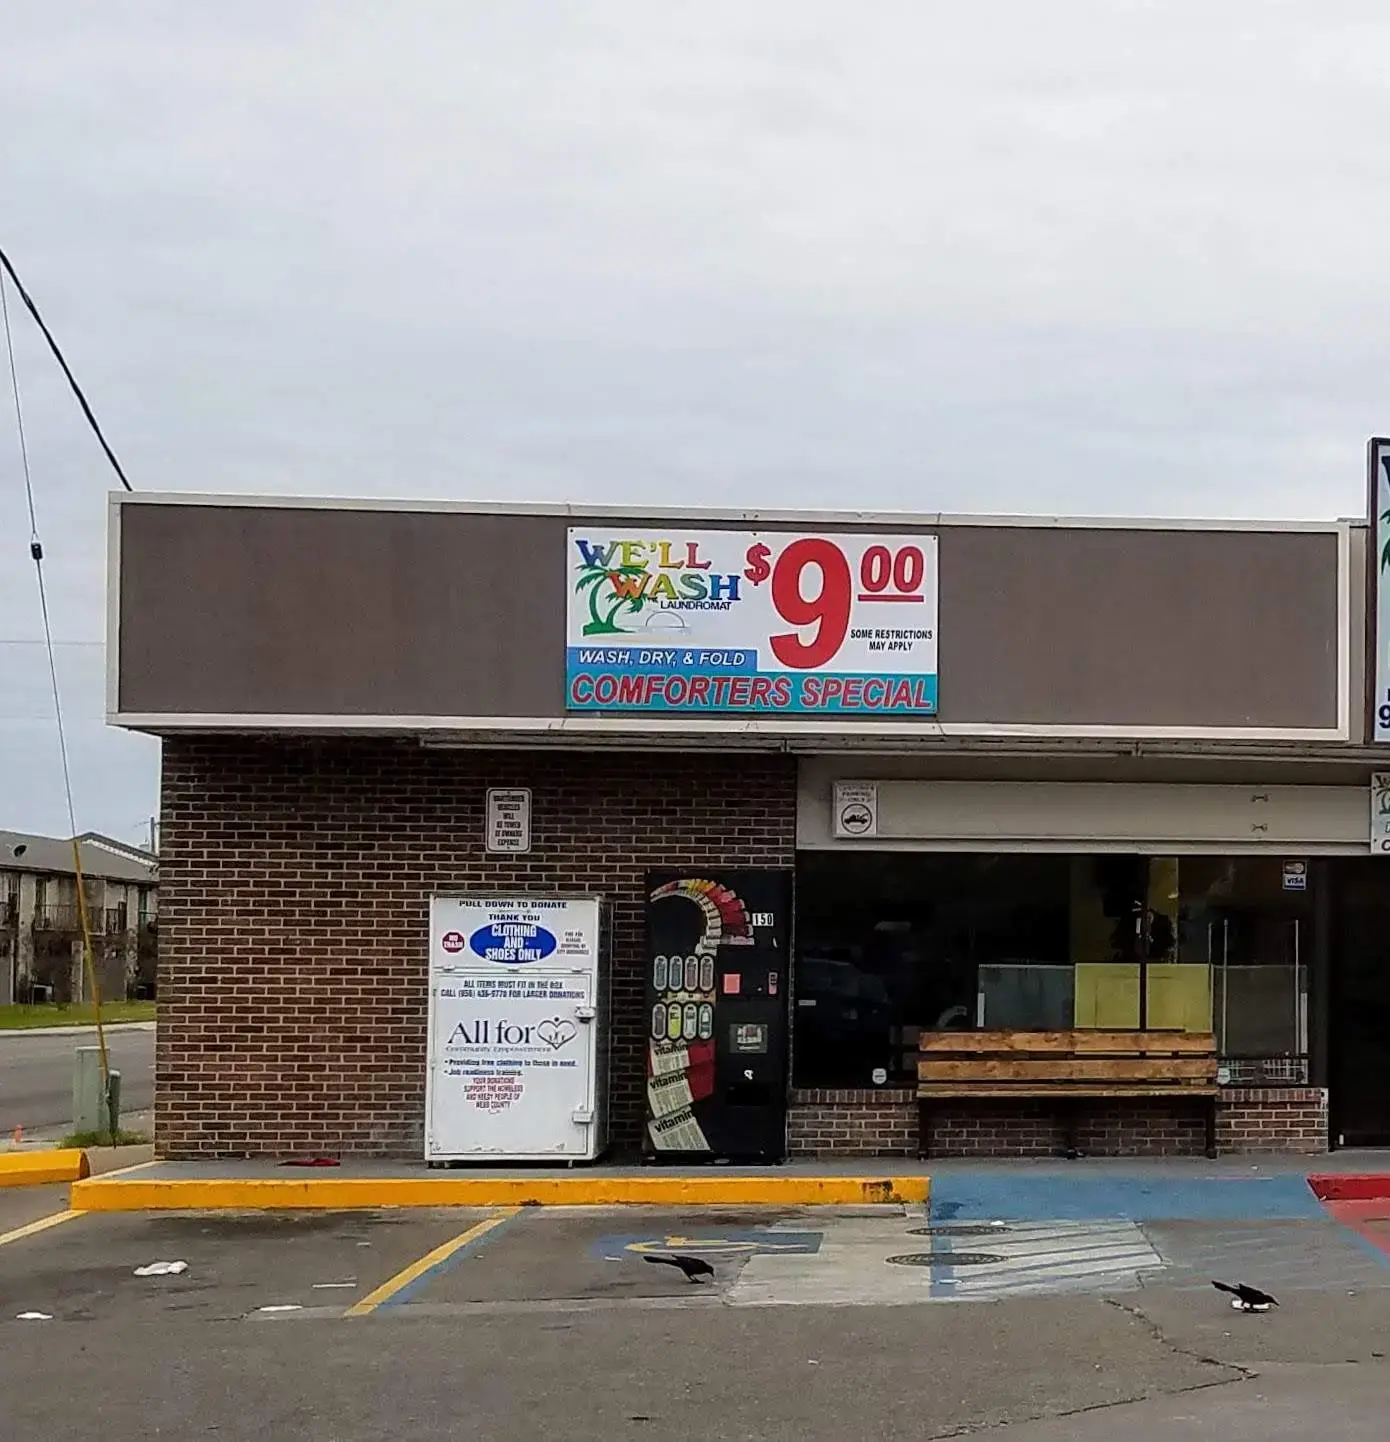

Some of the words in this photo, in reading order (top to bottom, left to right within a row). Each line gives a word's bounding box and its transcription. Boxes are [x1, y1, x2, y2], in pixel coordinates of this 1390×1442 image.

[575, 540, 711, 570] WE'LL
[607, 572, 741, 601] WASH
[660, 599, 731, 611] LAUNDROMAT
[850, 629, 872, 639] SOME
[874, 629, 933, 641] RESTRICTIONS
[869, 640, 886, 651] MAY
[888, 641, 913, 651] APPLY
[579, 651, 634, 665] WASH,
[638, 652, 676, 667] DRY,
[683, 653, 694, 665] &
[699, 653, 745, 666] FOLD
[572, 674, 793, 707] COMFORTERS
[801, 677, 934, 708] SPECIAL
[459, 900, 482, 908] PULL
[531, 901, 567, 909] DONATE
[491, 925, 537, 937] CLOTHING
[504, 937, 524, 949] AND
[485, 949, 516, 960] SHOES
[518, 949, 542, 961] ONLY
[441, 989, 456, 997] CALL
[448, 1020, 489, 1044] All
[495, 1020, 536, 1044] for
